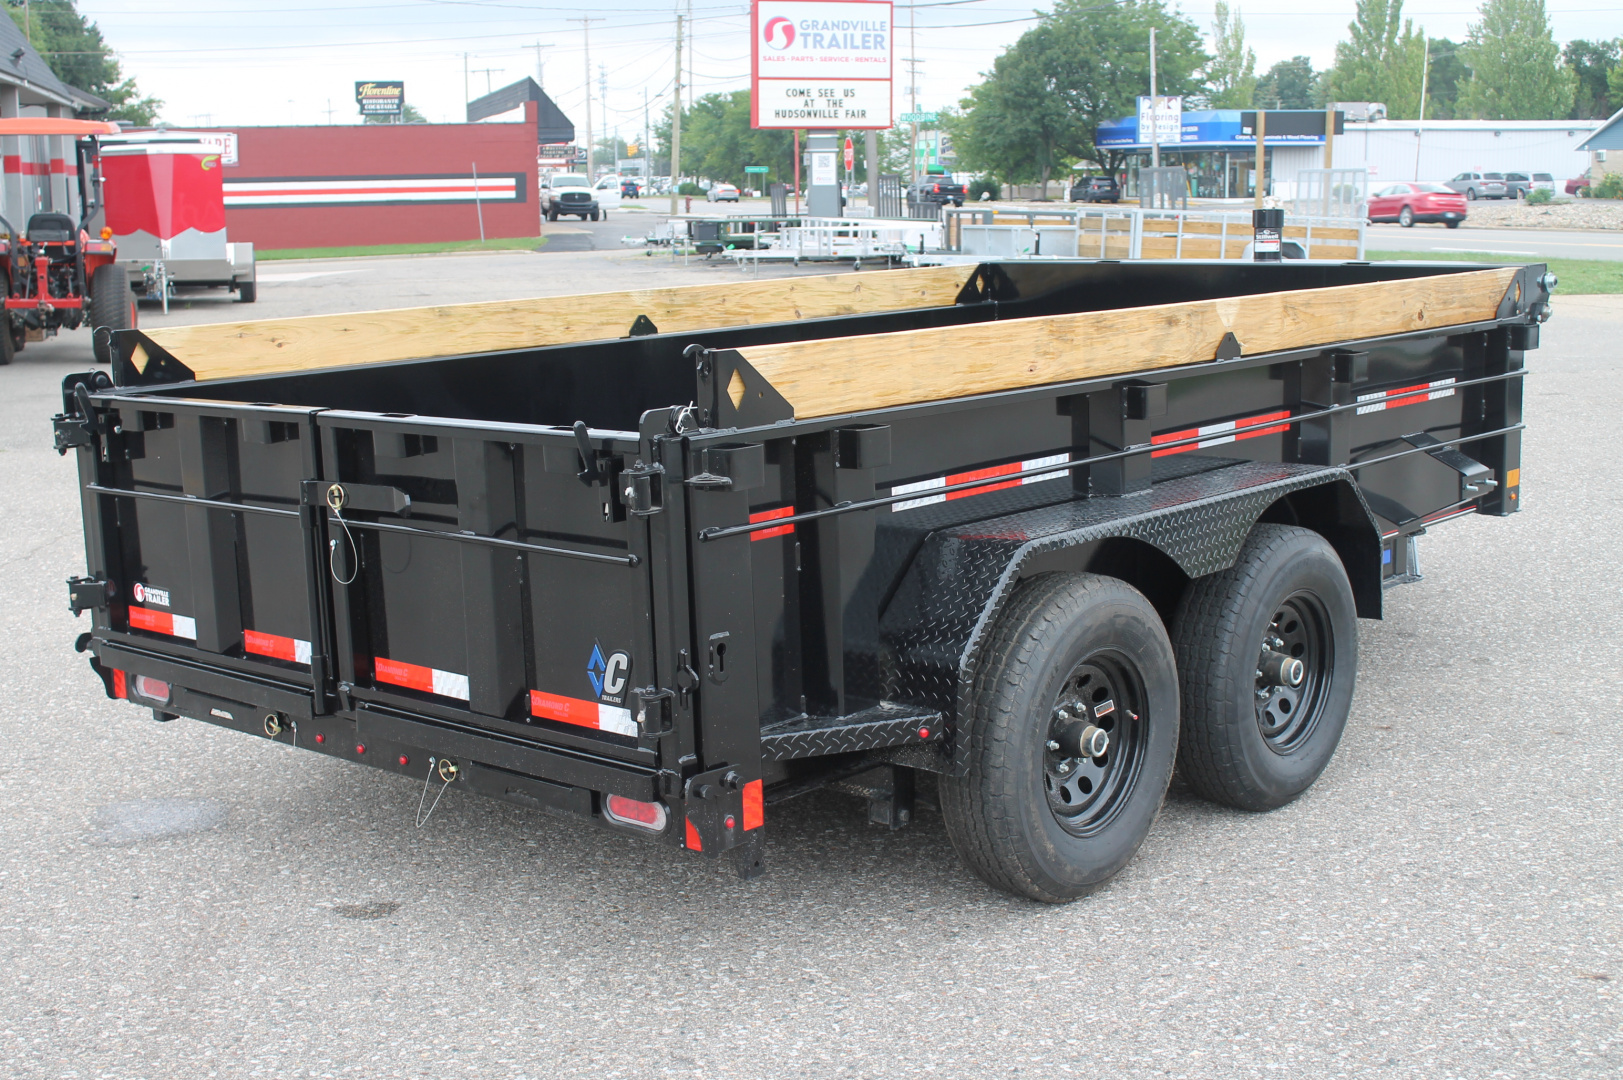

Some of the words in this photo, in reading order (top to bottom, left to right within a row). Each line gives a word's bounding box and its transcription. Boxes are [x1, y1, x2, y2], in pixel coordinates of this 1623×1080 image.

[799, 19, 887, 32] GRANDVILLE
[799, 32, 886, 50] TRAILER
[358, 83, 401, 99] Florentine
[785, 88, 812, 97] COME
[818, 88, 836, 97] SEE
[843, 89, 856, 97] US
[803, 99, 815, 108] AT
[826, 99, 844, 108] THE
[774, 109, 839, 118] HUDSONVILLE
[845, 109, 867, 118] FAIR
[901, 113, 938, 121] WOODBINE
[1141, 123, 1150, 132] by
[144, 586, 169, 598] GRANDVILLE
[144, 593, 170, 607] TRAILER
[603, 653, 628, 694] C
[535, 697, 563, 711] DIAMOND
[564, 703, 570, 712] C
[602, 695, 622, 704] TRAILERS
